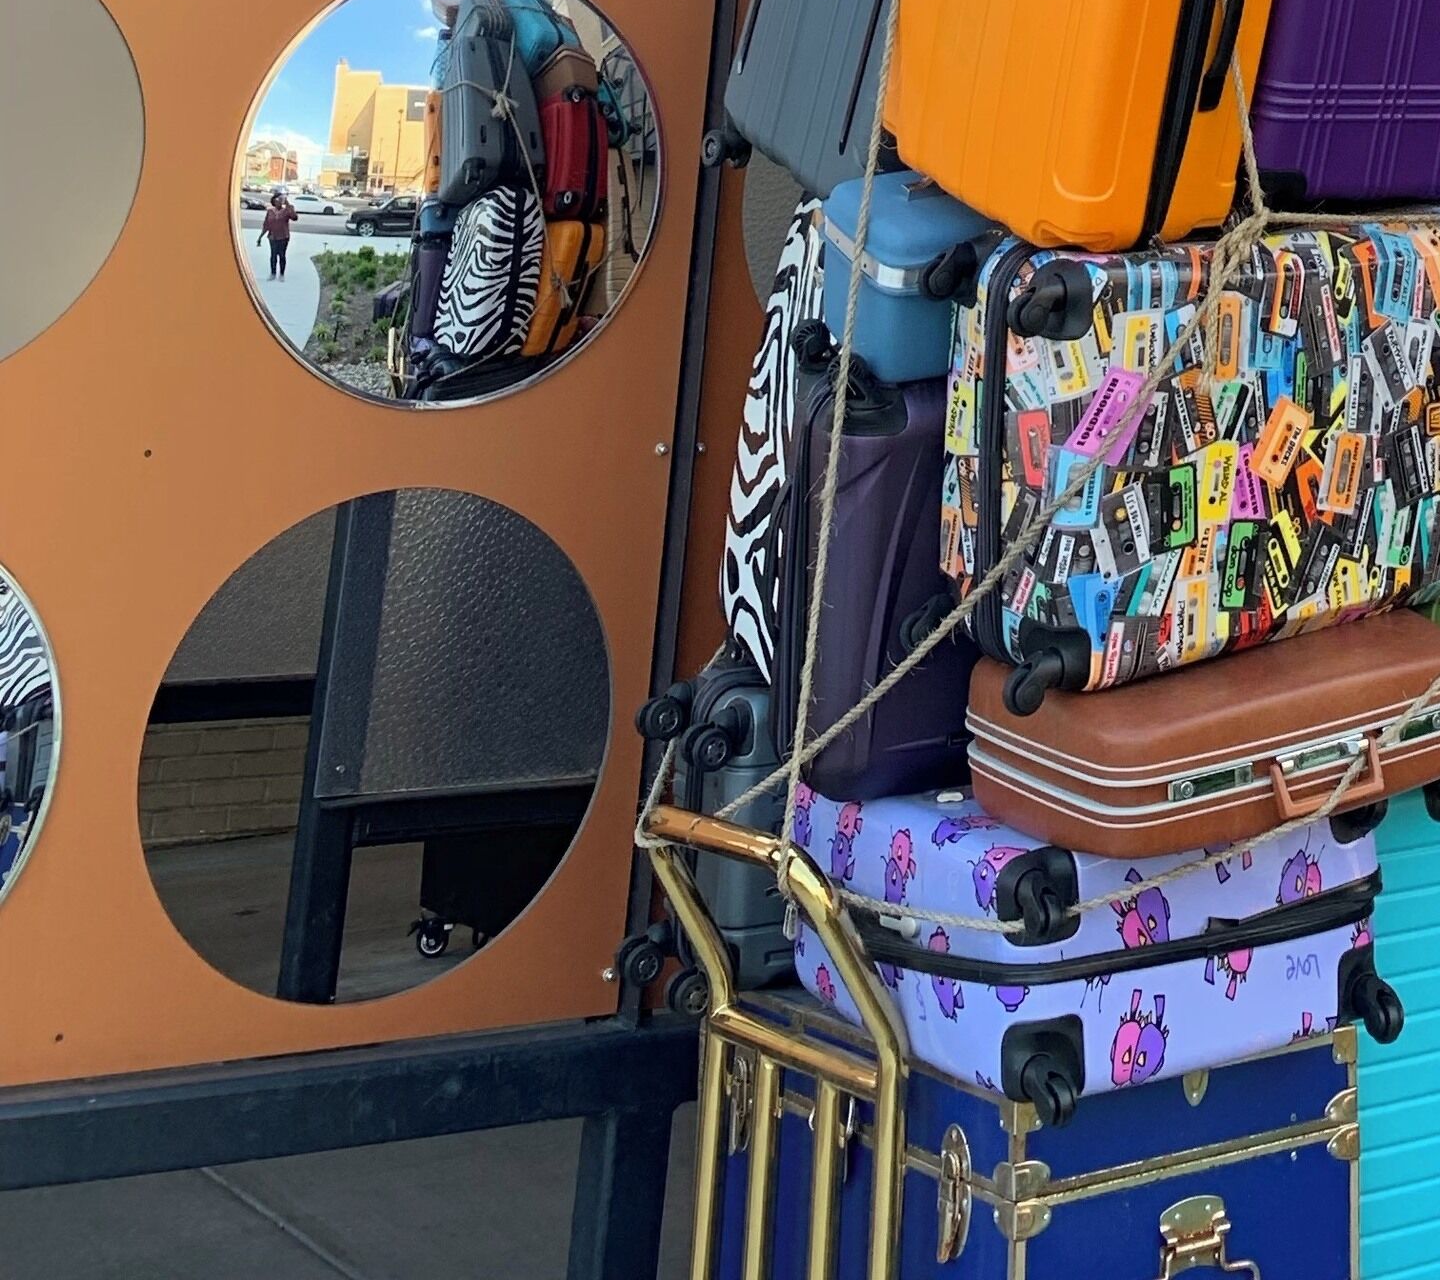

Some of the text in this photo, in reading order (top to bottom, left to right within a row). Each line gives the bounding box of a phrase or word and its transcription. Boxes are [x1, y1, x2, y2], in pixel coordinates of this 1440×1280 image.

[1076, 377, 1120, 447] LOUDMOUTH
[1218, 454, 1233, 507] WEIRD AL
[1285, 953, 1322, 981] Love
